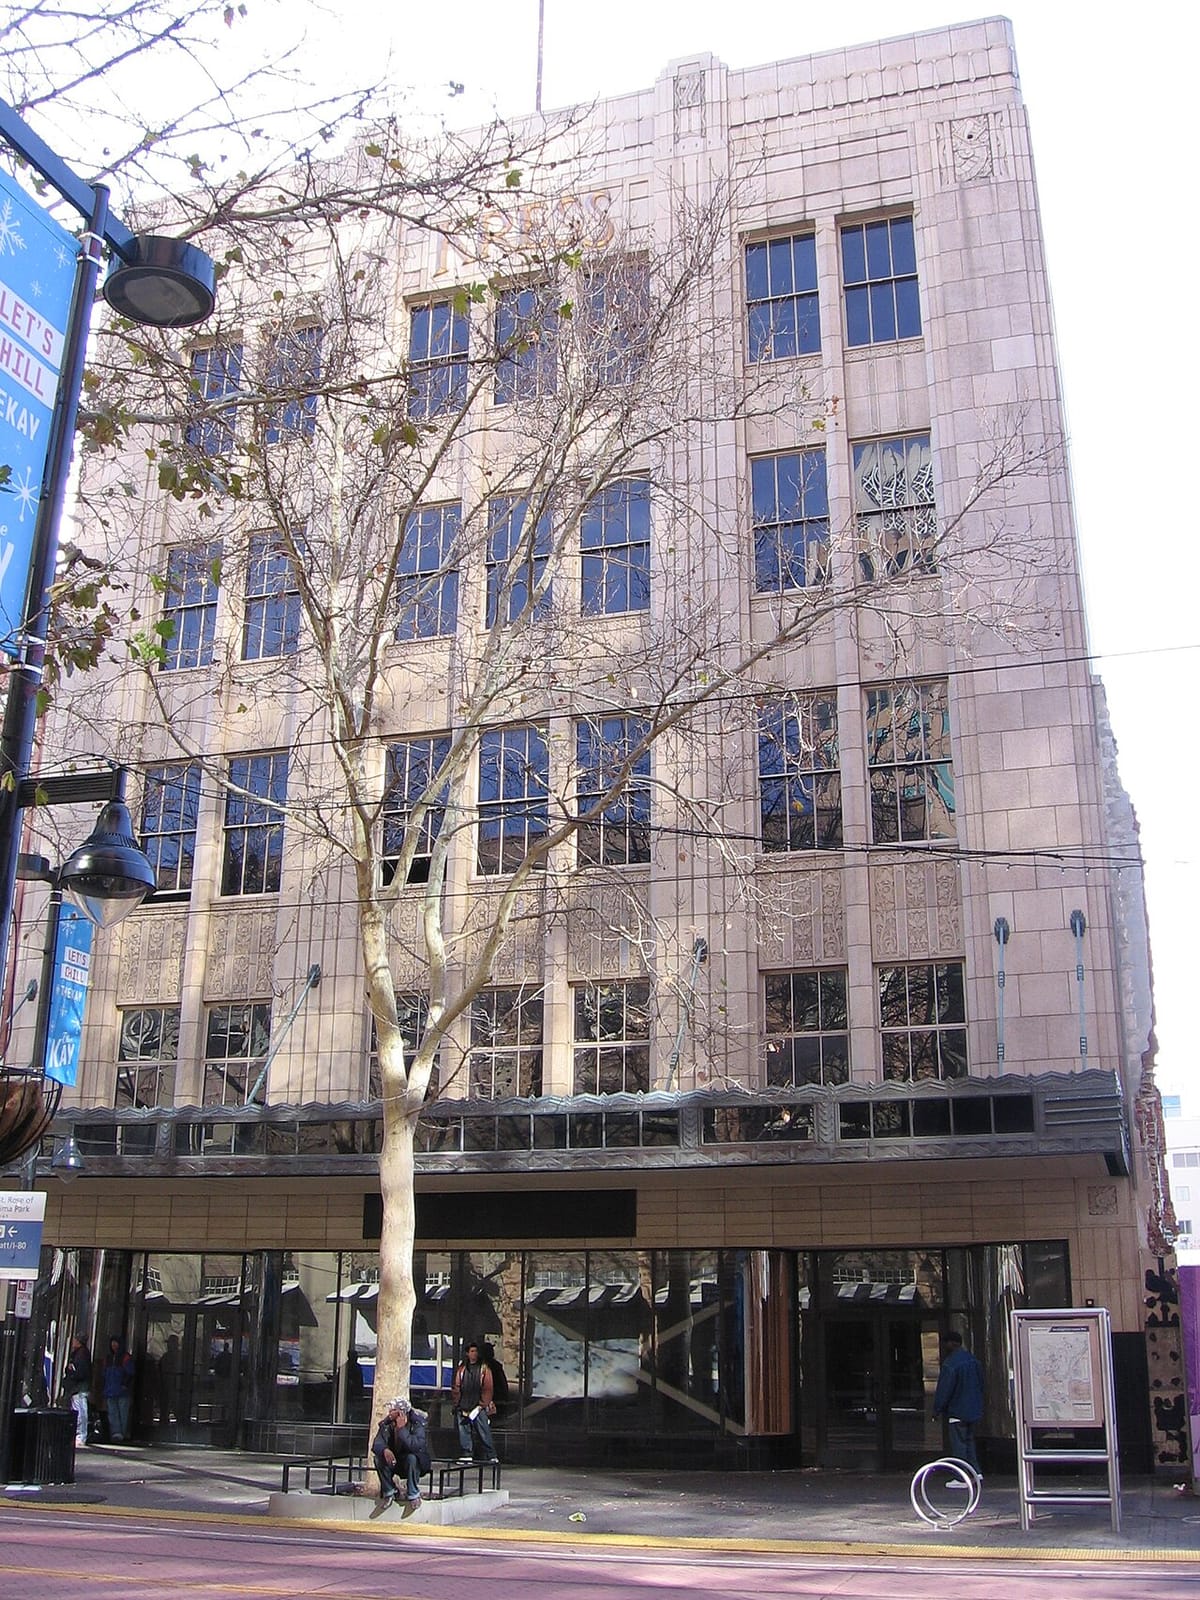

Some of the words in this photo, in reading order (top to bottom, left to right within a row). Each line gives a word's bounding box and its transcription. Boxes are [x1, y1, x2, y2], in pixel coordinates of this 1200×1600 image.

[0, 290, 54, 355] LET'S
[68, 949, 87, 966] LET'S
[48, 1038, 75, 1068] KAY
[25, 1196, 34, 1204] of
